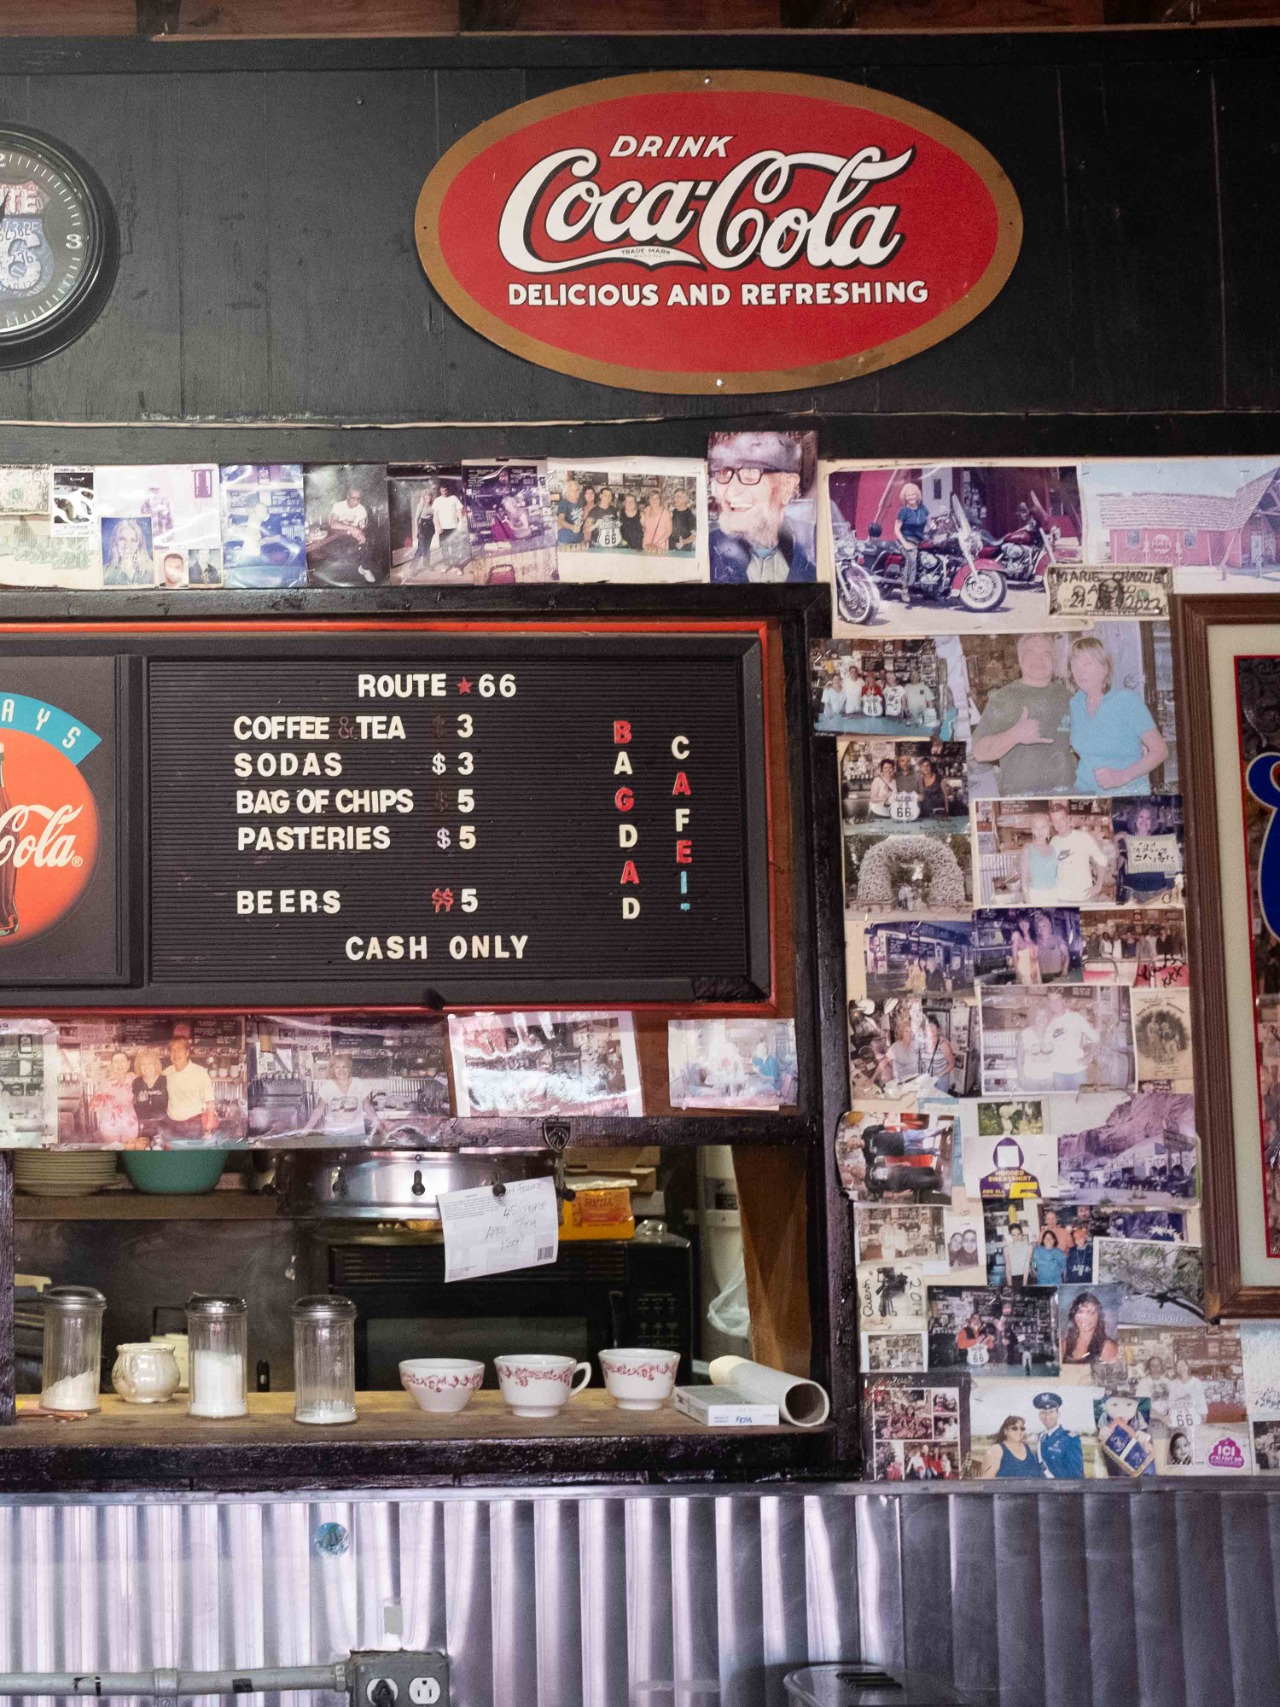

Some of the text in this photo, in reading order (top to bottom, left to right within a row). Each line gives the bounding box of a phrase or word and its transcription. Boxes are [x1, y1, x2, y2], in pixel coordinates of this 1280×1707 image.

[609, 135, 734, 159] DRINK
[497, 145, 915, 274] Coca-Cola
[65, 234, 82, 249] 3
[507, 280, 929, 307] DELICIOUS AND REFRESHING
[358, 673, 517, 698] ROUTE 66
[233, 716, 330, 741] COFFEE
[355, 716, 406, 740] TEA
[234, 752, 343, 777] SODAS
[235, 790, 290, 815] BAG
[296, 789, 330, 814] OF
[335, 789, 414, 814] CHIPS
[613, 719, 641, 921] BAGDAD
[237, 826, 391, 852] PASTERIES
[236, 889, 342, 915] BEERS
[345, 935, 529, 961] CASH ONLY
